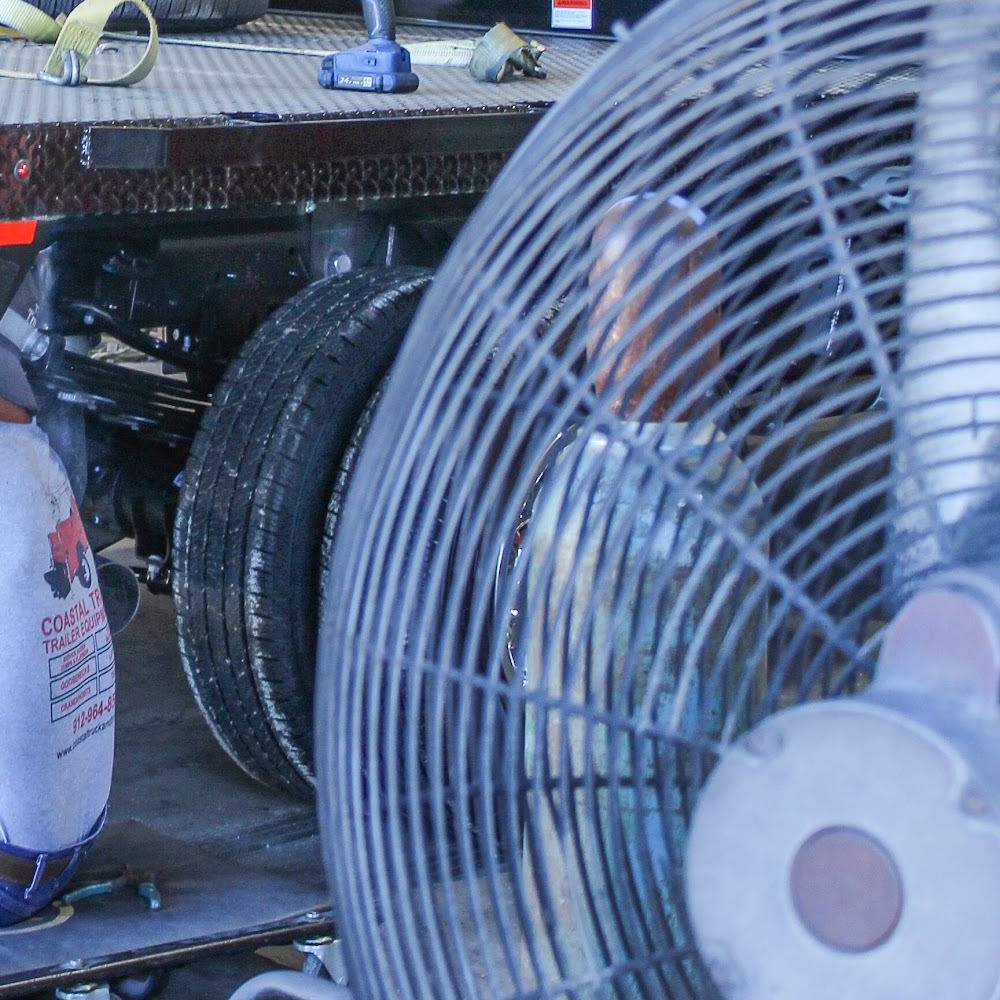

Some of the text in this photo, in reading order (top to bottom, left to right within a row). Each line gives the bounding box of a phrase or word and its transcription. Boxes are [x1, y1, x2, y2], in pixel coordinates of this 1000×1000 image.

[41, 599, 89, 637] COASTAL
[88, 588, 103, 610] TR
[42, 626, 81, 654] TRAILER
